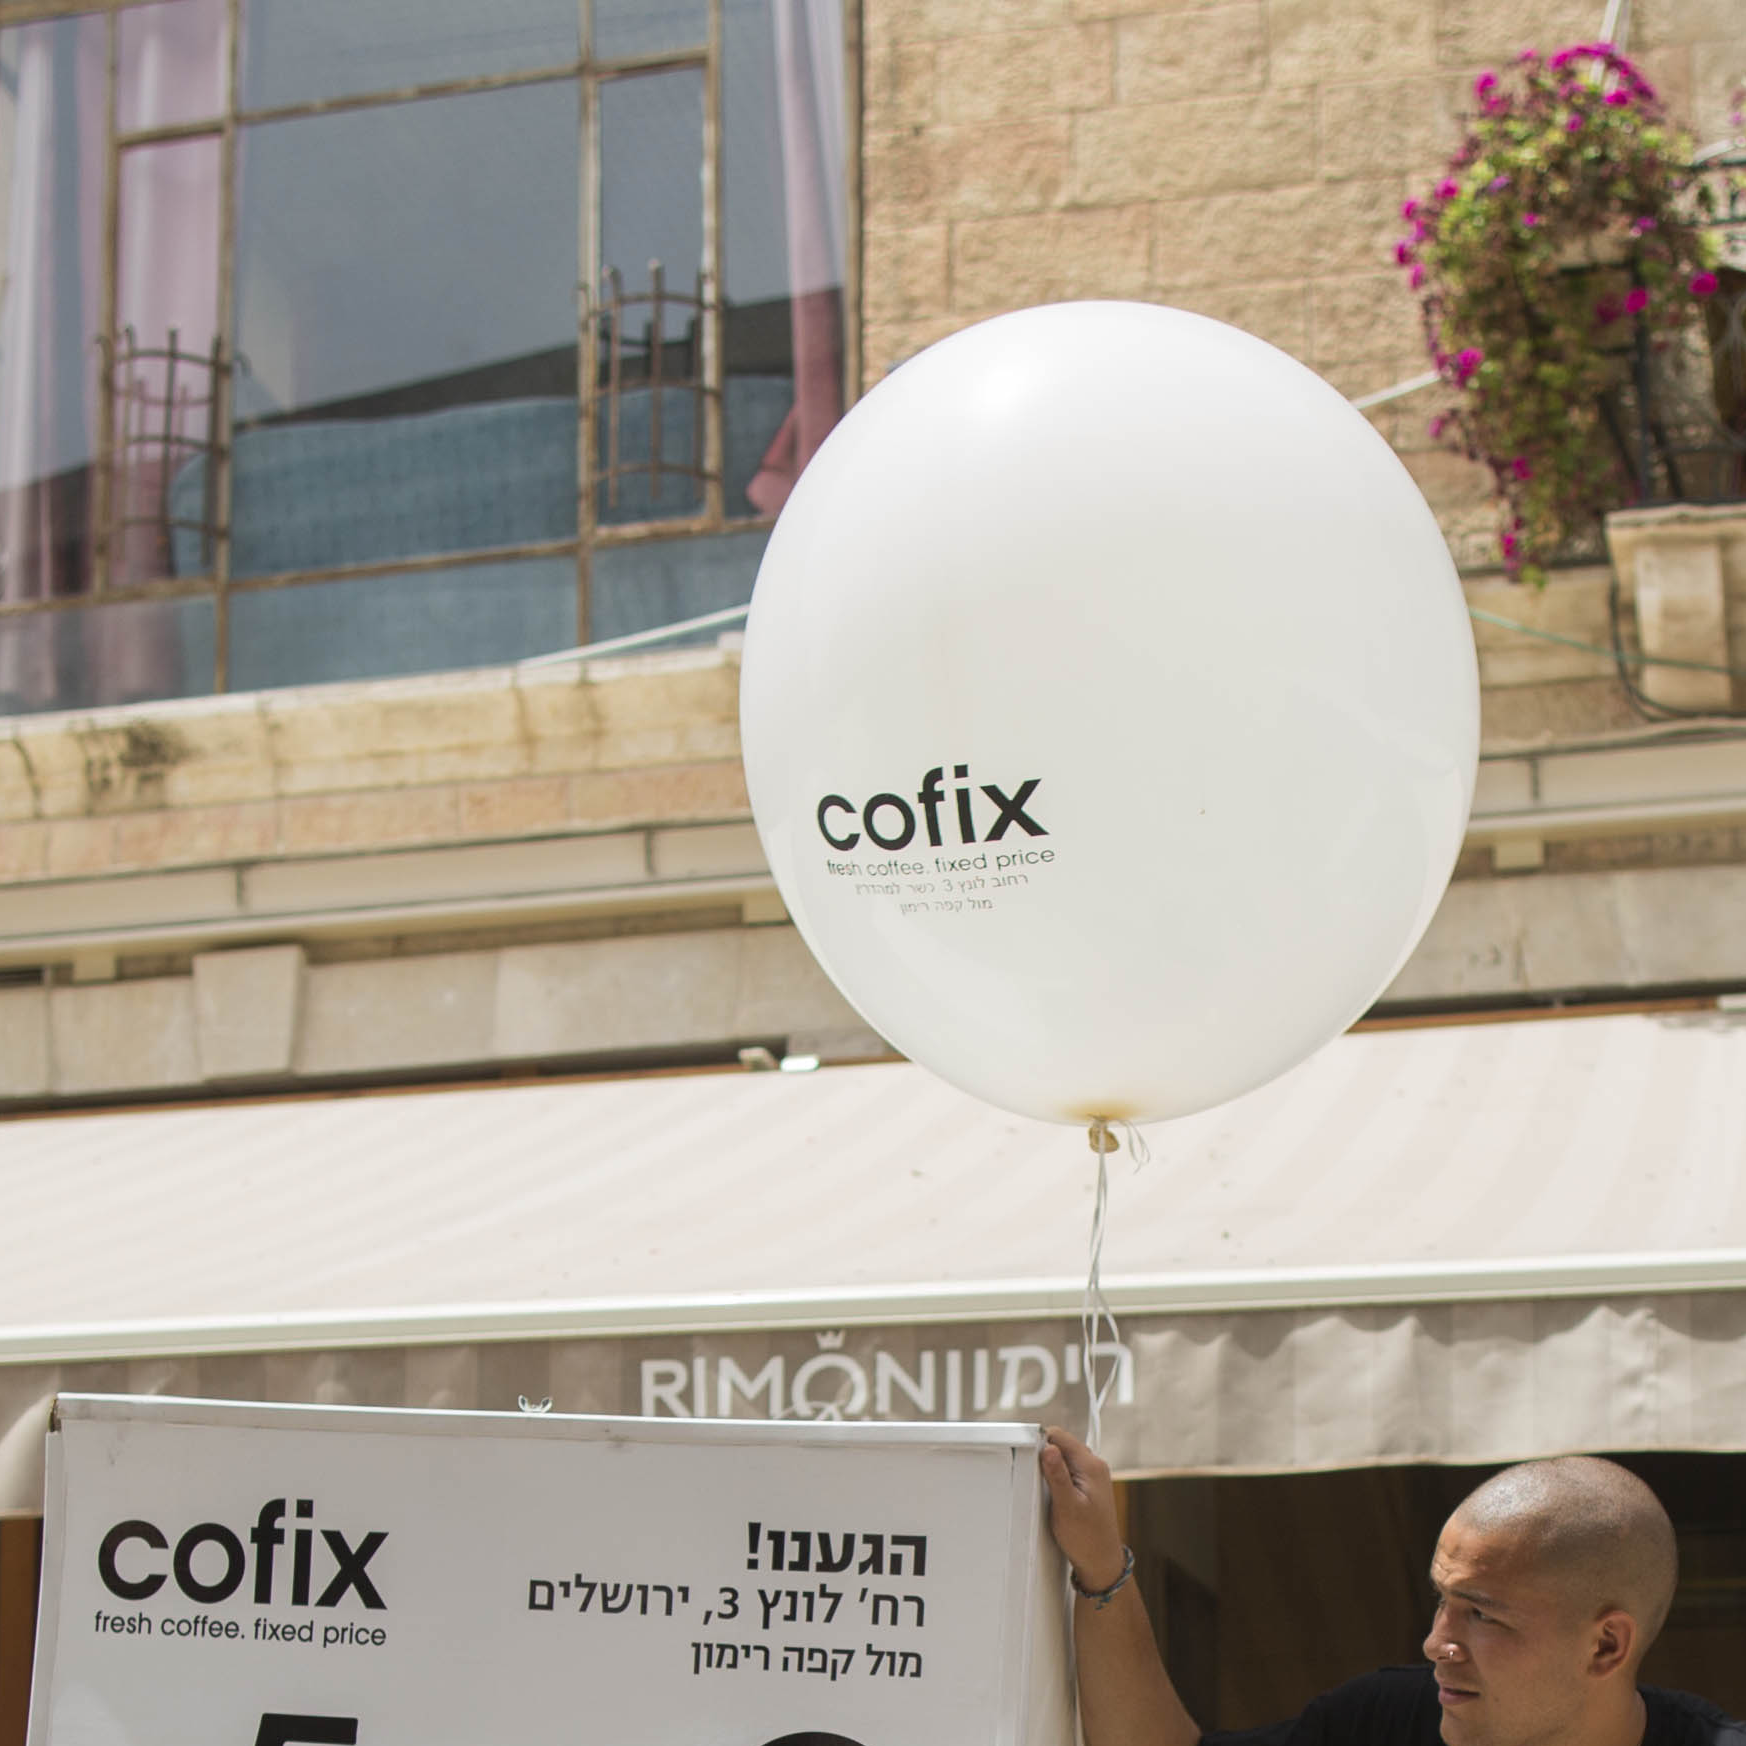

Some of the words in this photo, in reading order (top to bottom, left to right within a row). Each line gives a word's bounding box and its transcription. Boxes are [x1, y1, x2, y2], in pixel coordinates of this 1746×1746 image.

[816, 763, 1050, 852] cofix
[826, 859, 863, 877] fresh
[935, 853, 988, 873] fixed
[996, 849, 1055, 871] price
[943, 878, 954, 893] 3
[97, 1497, 390, 1611] cofix
[745, 1521, 929, 1577] הגענו!
[527, 1572, 690, 1617] ירושלים
[756, 1583, 844, 1630] לונץ
[94, 1610, 153, 1635] fresh
[160, 1615, 246, 1640] coffee.
[253, 1618, 315, 1643] fixed
[322, 1623, 388, 1649] price
[690, 1640, 771, 1676] רימון
[781, 1645, 856, 1683] קפה
[866, 1643, 924, 1679] מול
